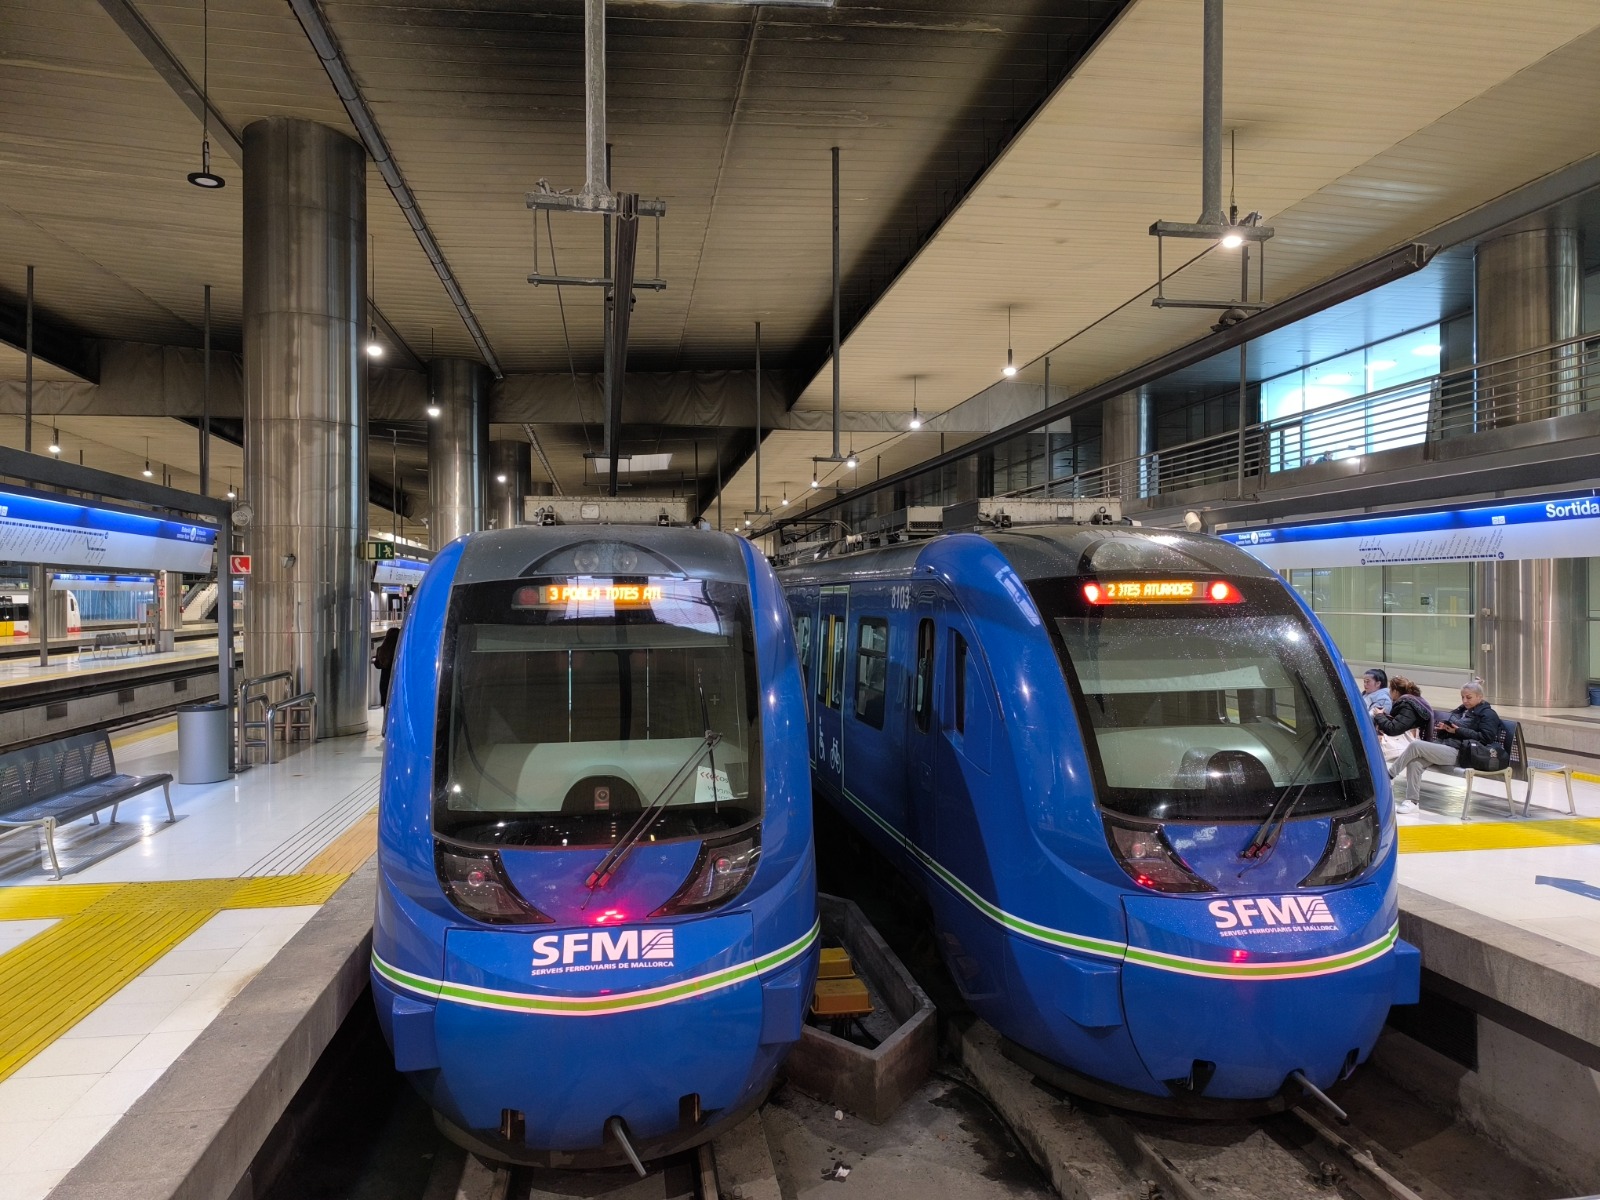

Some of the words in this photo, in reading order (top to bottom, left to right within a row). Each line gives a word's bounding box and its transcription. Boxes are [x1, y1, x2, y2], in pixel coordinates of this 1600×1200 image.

[1545, 500, 1600, 518] Sortida
[549, 587, 559, 600] 3
[605, 587, 640, 601] TOTES
[891, 585, 910, 609] 8103
[1107, 584, 1116, 597] 2
[1143, 583, 1194, 597] ATURADES
[1208, 897, 1306, 929] SFM
[1219, 929, 1249, 938] SERVEIS
[1248, 926, 1293, 935] FERROVIARIS
[531, 930, 639, 967] SFM
[531, 967, 564, 976] SERVEIS
[565, 963, 617, 973] FERROVIARIS
[630, 961, 675, 969] MALLORCA
